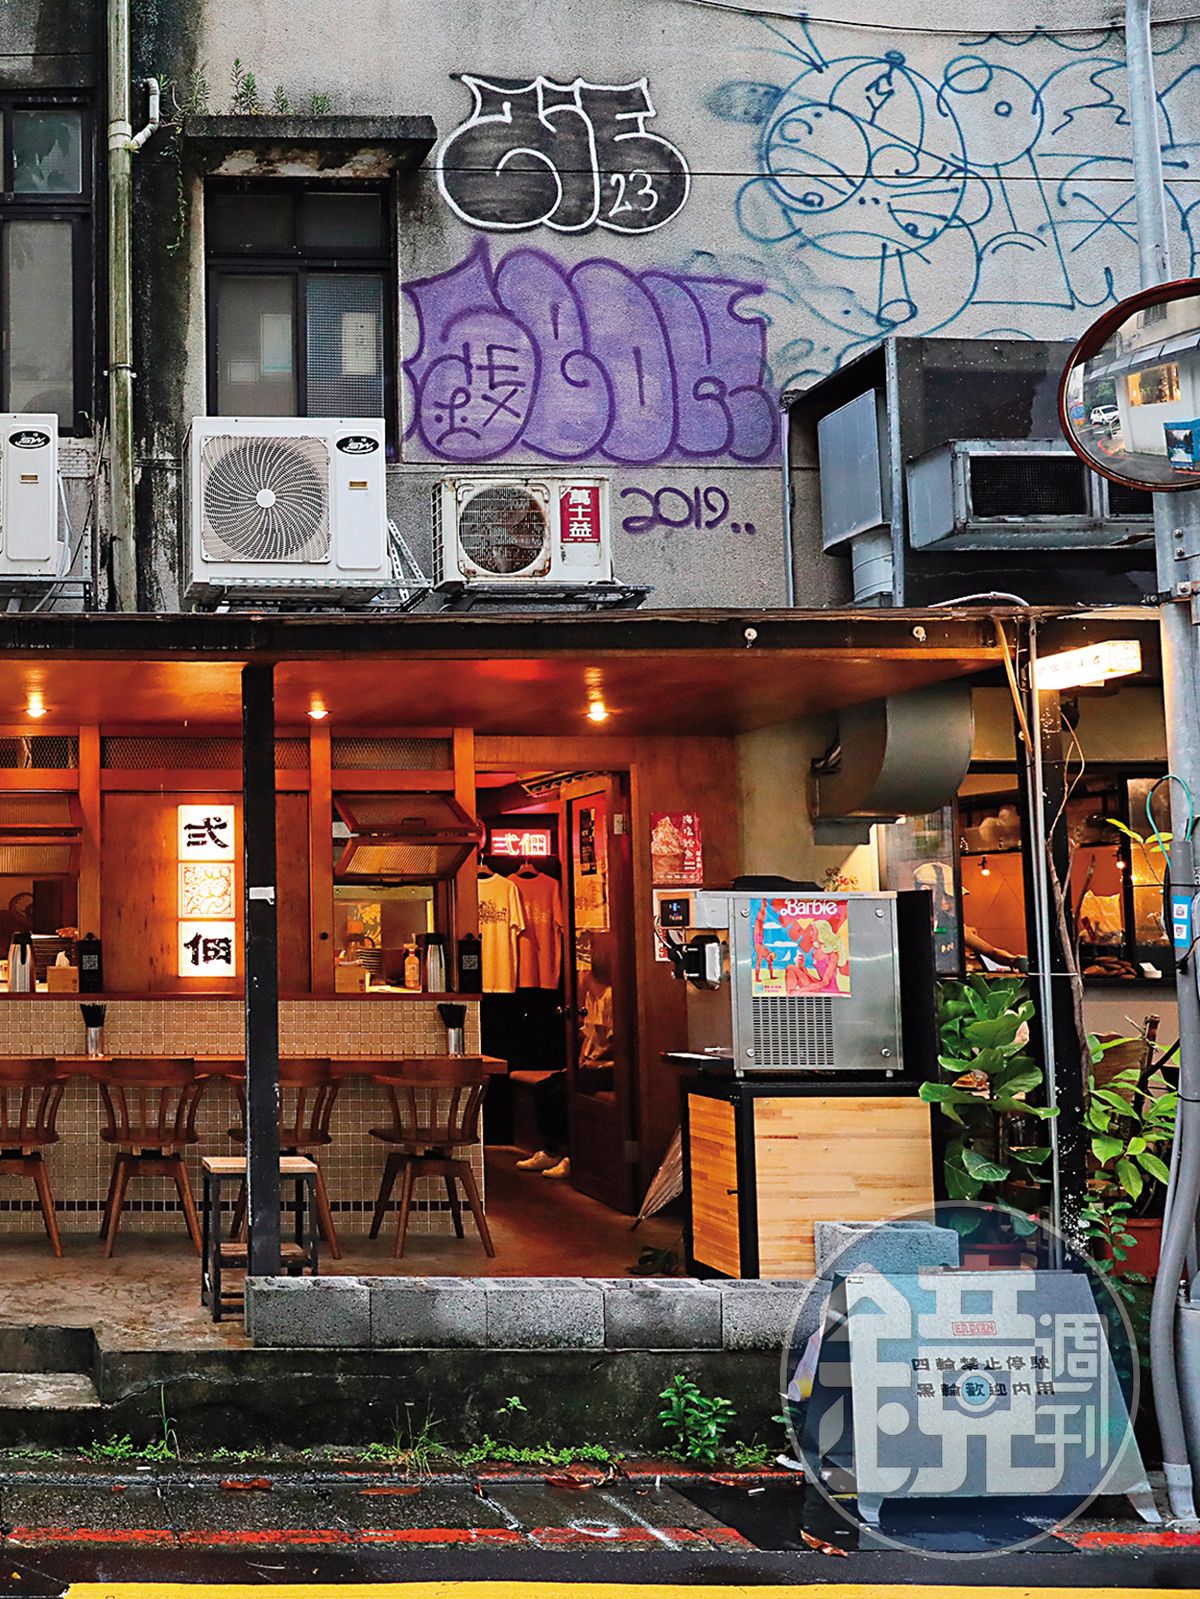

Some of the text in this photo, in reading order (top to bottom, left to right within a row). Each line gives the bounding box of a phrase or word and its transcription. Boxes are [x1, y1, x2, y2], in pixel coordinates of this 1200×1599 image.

[608, 169, 658, 217] 23
[569, 488, 592, 537] 萬士益
[780, 897, 838, 916] Barbie
